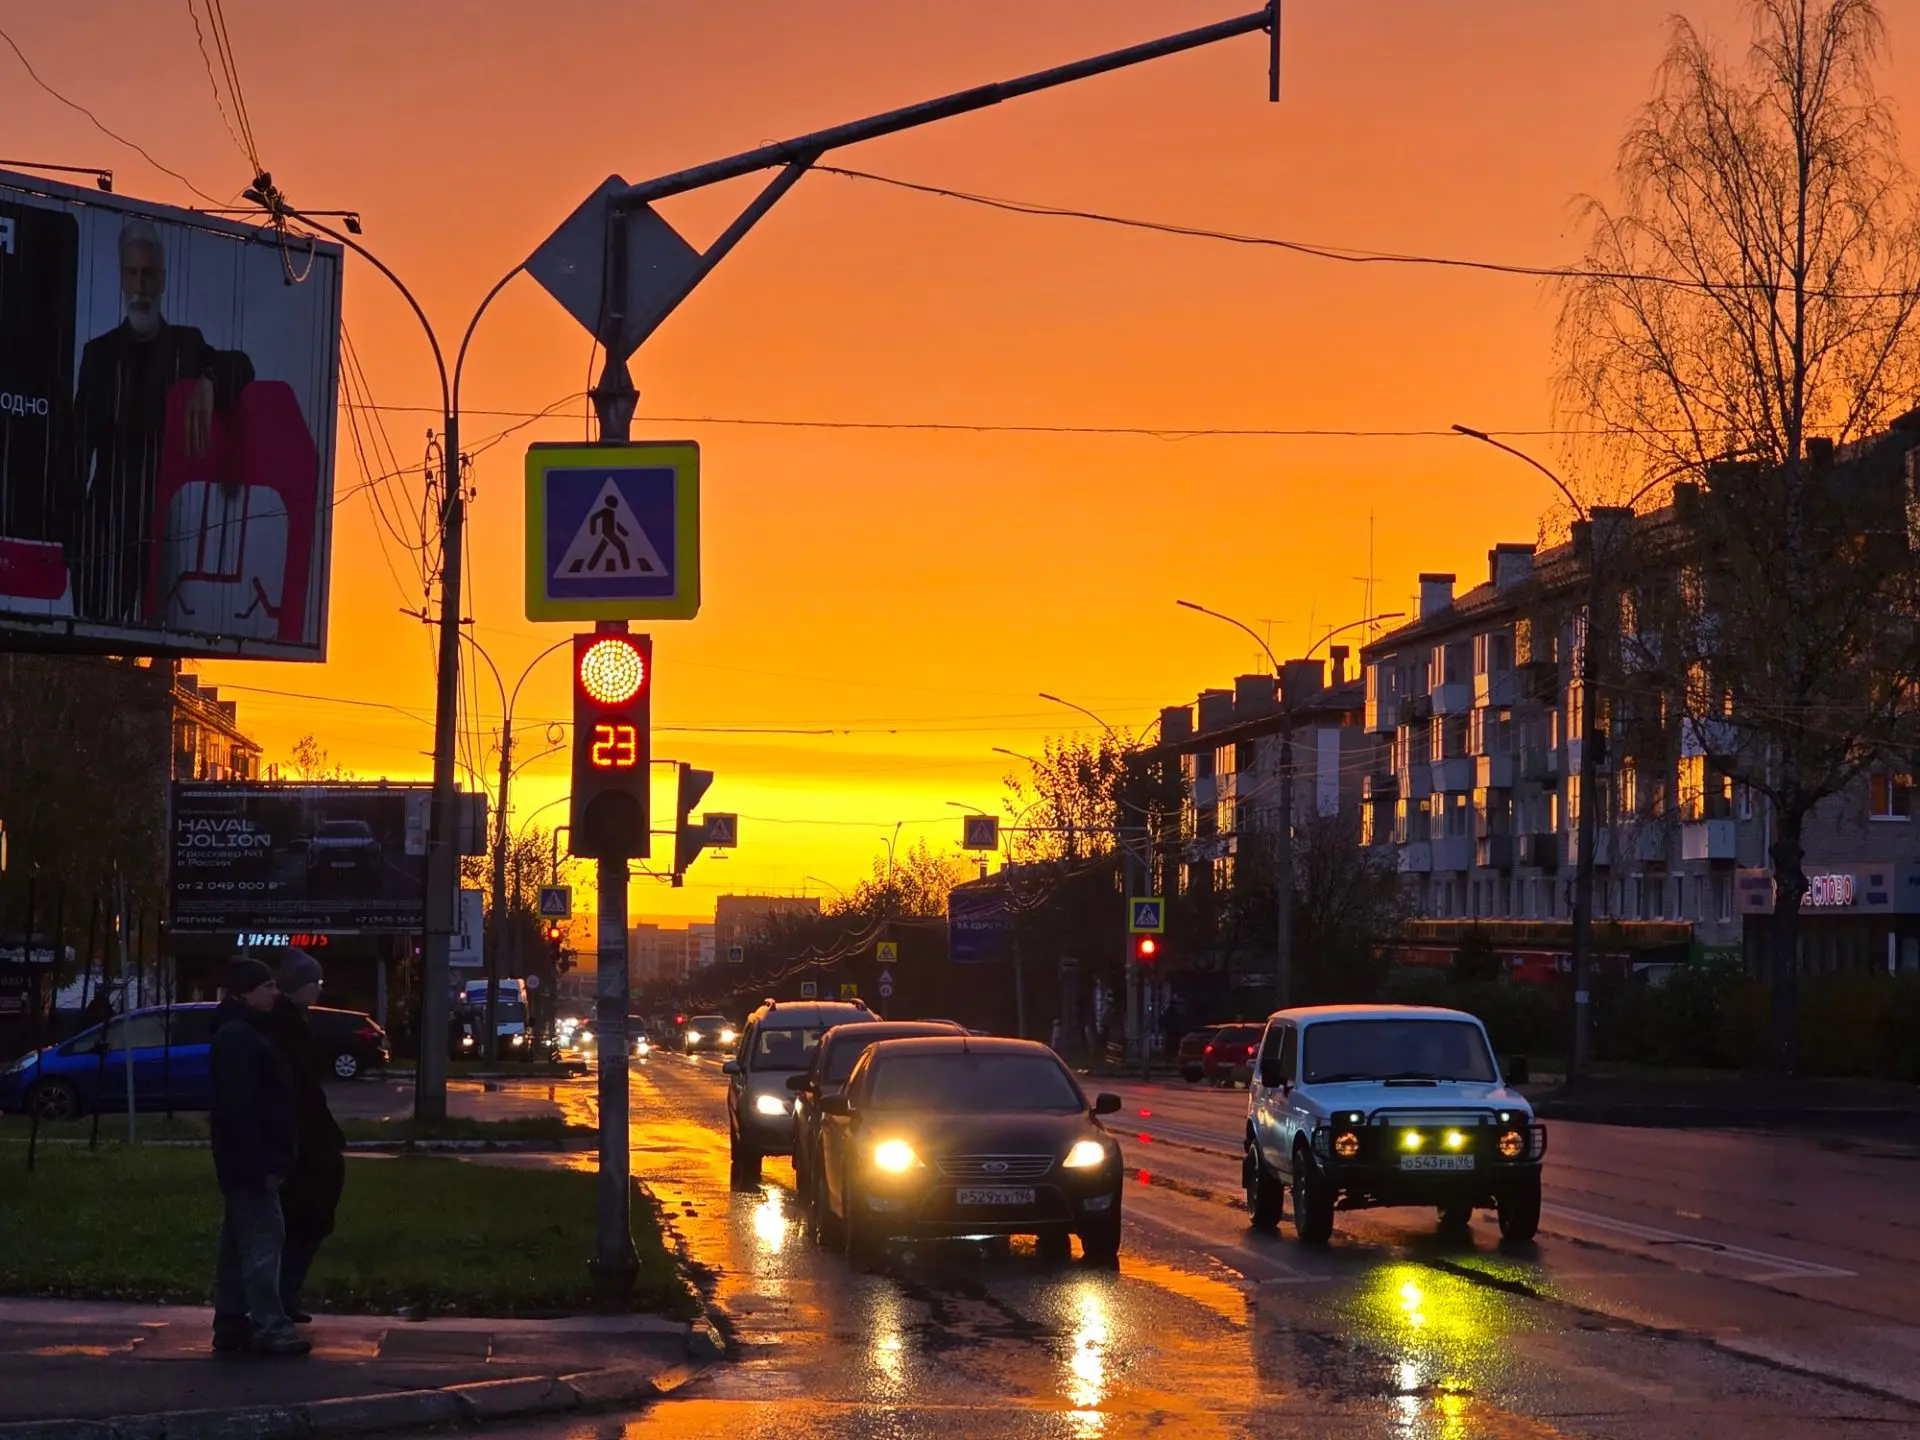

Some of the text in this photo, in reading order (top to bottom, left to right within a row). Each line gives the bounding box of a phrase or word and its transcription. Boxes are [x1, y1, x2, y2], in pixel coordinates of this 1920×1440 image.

[593, 724, 635, 766] 23
[178, 818, 254, 832] HAVAL
[178, 833, 271, 847] JOLION
[195, 881, 204, 890] 2
[207, 881, 235, 890] 049
[238, 881, 265, 890] 000
